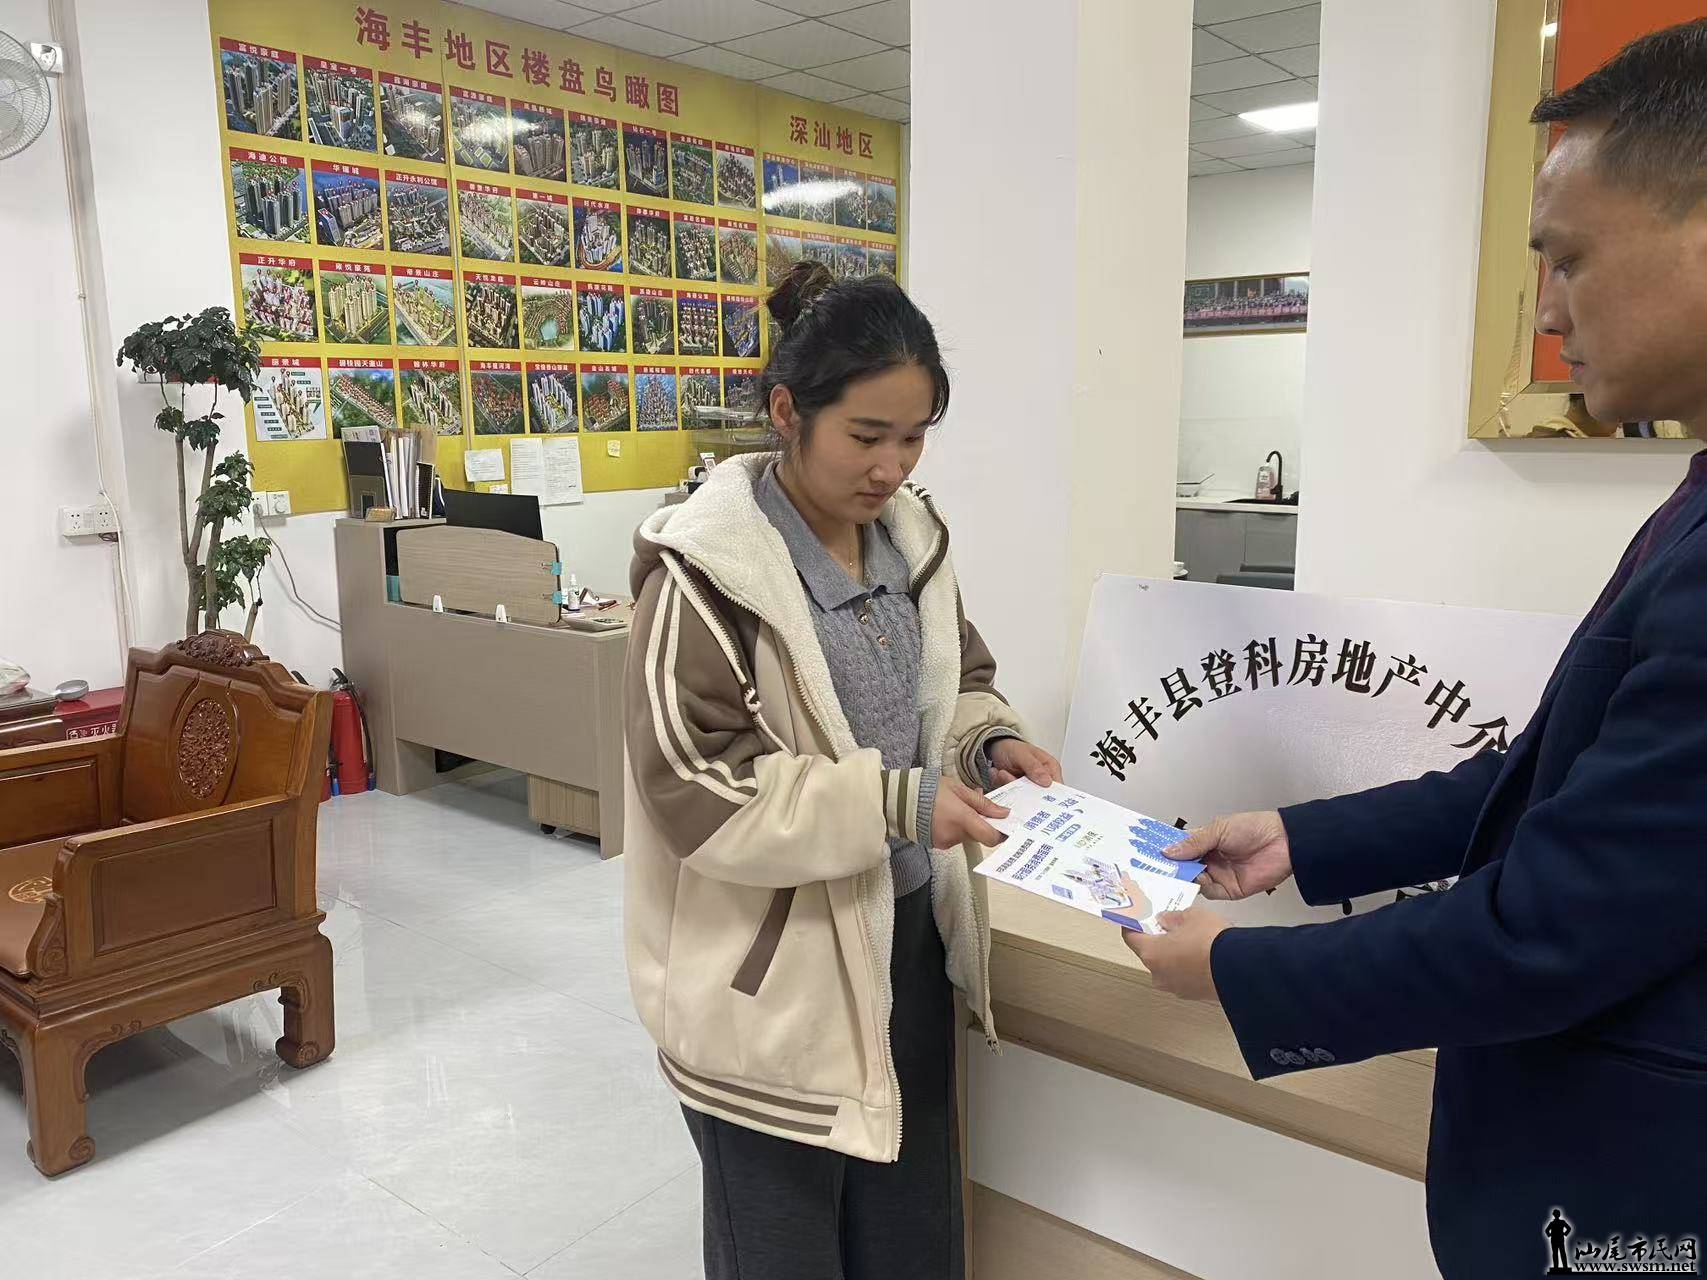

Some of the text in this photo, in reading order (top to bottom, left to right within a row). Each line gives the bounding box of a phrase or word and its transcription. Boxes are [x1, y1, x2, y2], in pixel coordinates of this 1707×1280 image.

[354, 6, 680, 117] 海丰地区楼盘鸟瞰图
[789, 115, 873, 159] 深汕地区
[257, 256, 297, 268] 正升华府
[1090, 633, 1514, 782] 海丰县登科房地产中介
